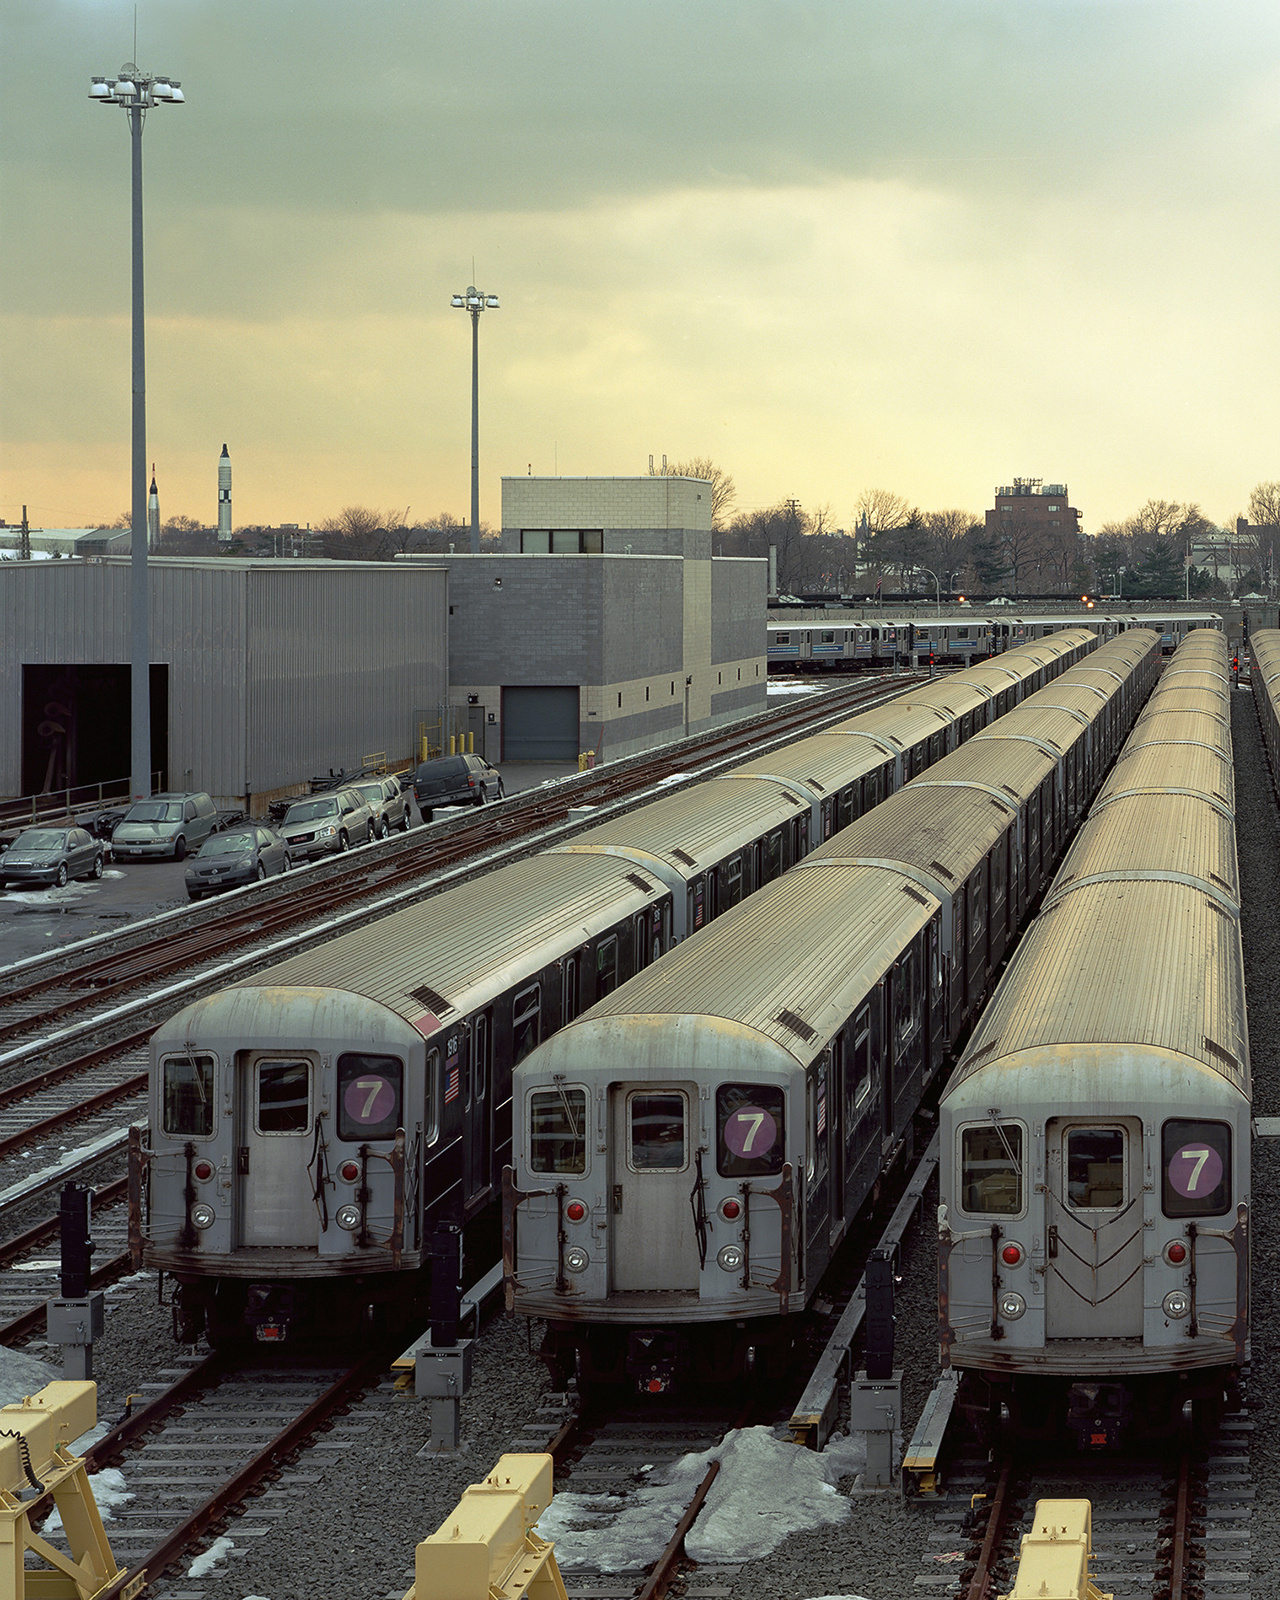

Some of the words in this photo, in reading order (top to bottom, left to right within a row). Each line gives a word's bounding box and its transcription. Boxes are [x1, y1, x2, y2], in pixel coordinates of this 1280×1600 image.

[355, 1082, 383, 1117] 7
[736, 1113, 765, 1151] 7
[1181, 1150, 1209, 1190] 7
